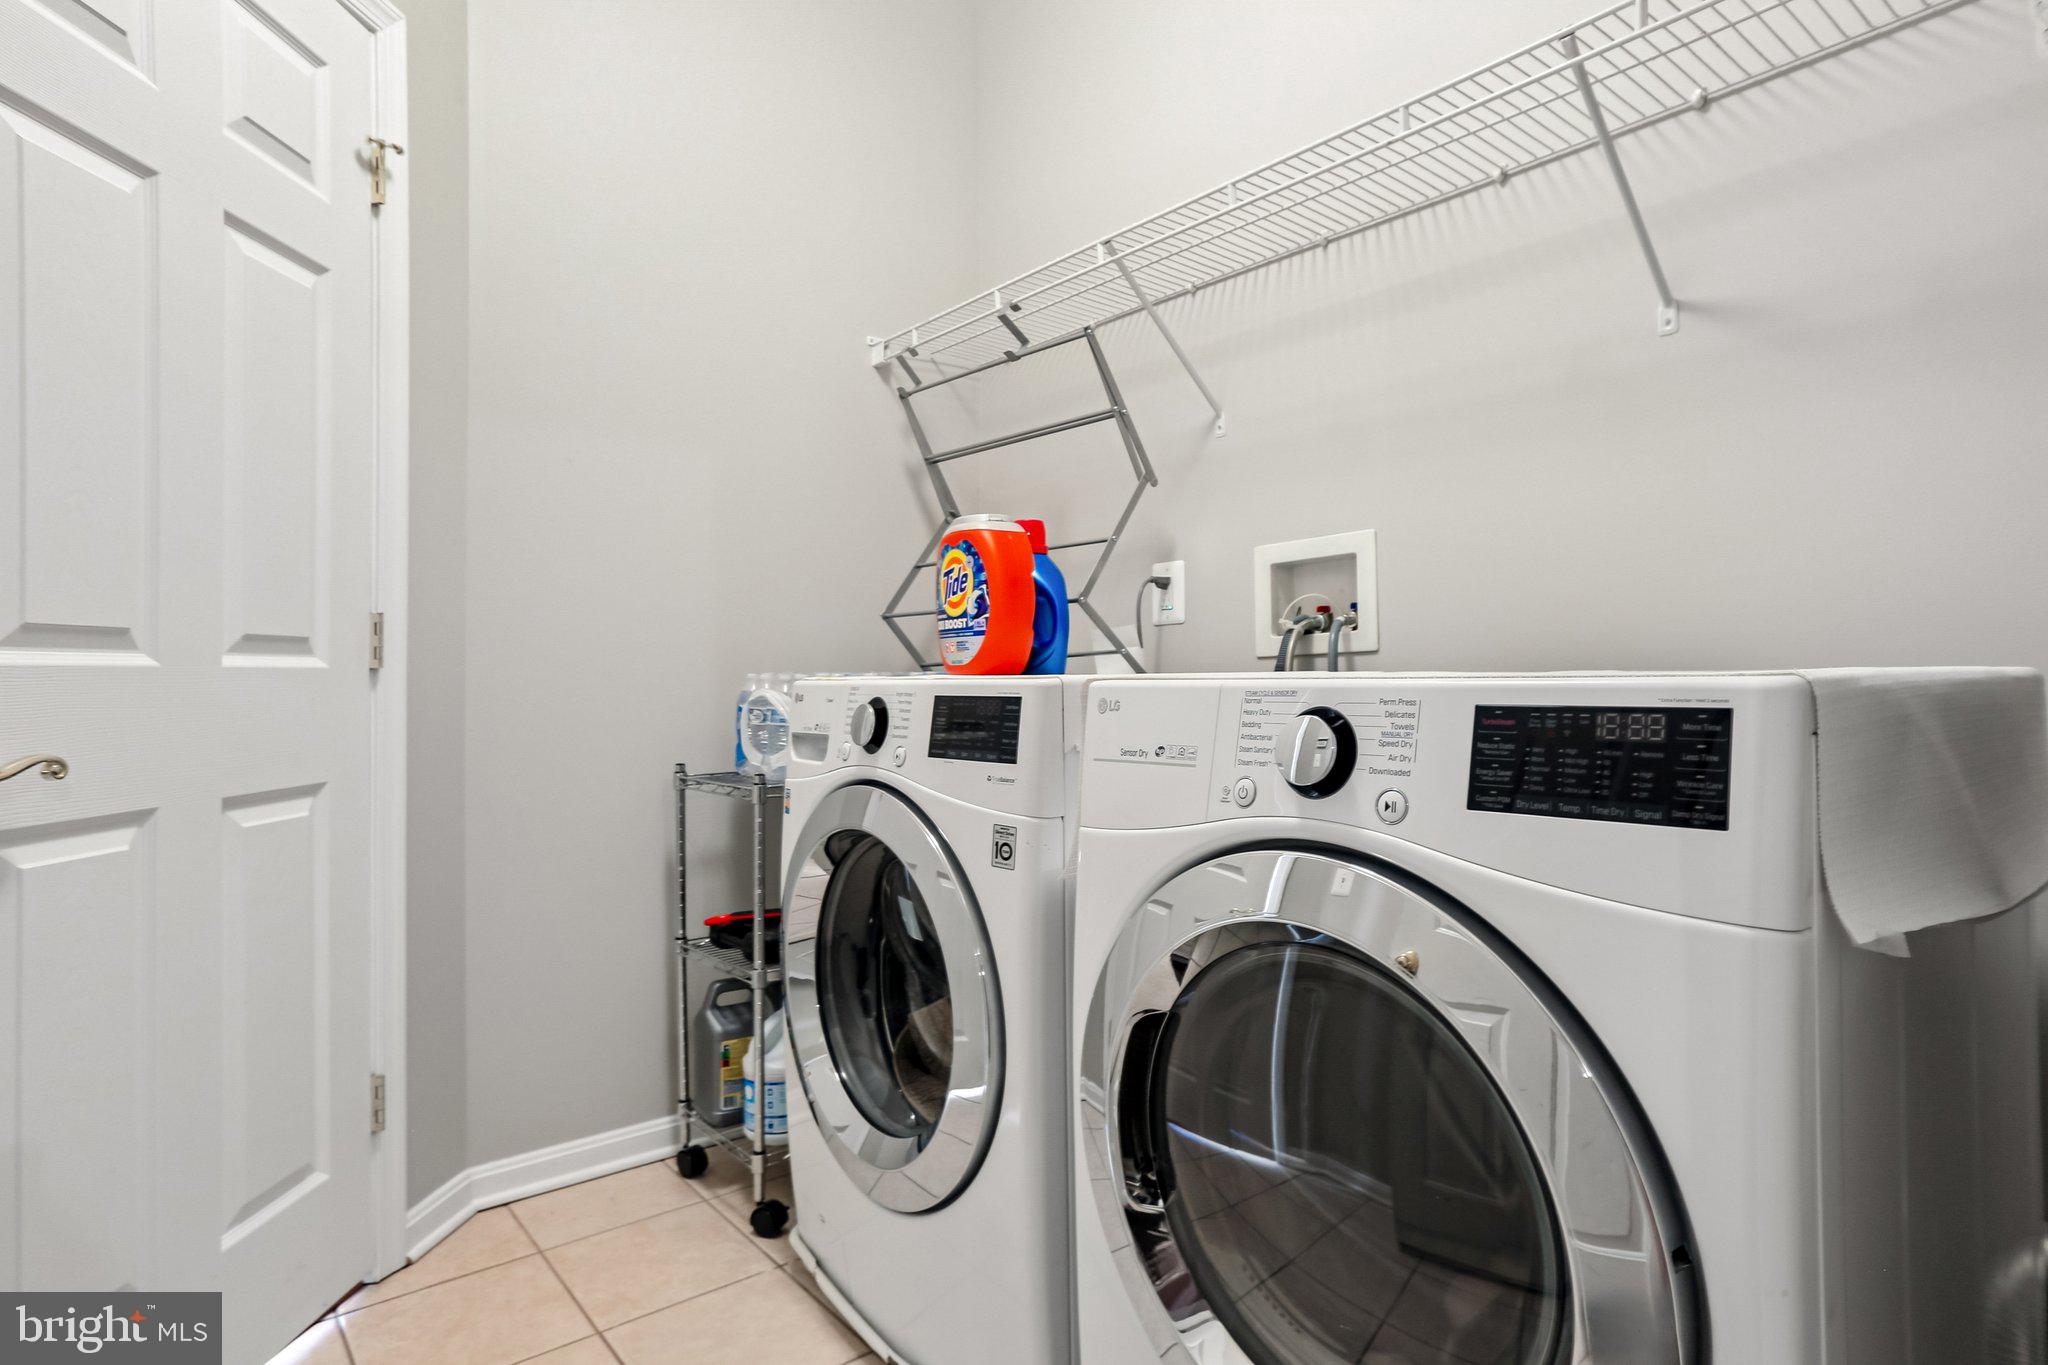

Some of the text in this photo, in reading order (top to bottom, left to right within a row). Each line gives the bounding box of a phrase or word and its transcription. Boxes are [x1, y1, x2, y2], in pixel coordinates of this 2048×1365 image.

[944, 567, 968, 604] Tide
[1109, 700, 1120, 711] LG
[1398, 698, 1416, 706] Press
[1259, 708, 1271, 716] Duty
[1385, 710, 1416, 719] Delicates
[1242, 720, 1261, 729] Bedding
[1391, 722, 1415, 730] Towels
[1378, 739, 1413, 749] Speed Dry
[1120, 748, 1148, 759] Sensor Dry
[1400, 754, 1412, 763] Dry
[1368, 766, 1411, 777] Downloaded
[1516, 800, 1549, 810] Dry Level
[1558, 803, 1580, 813] Temp
[1592, 805, 1625, 817] Time Dry
[1634, 809, 1662, 820] Signal
